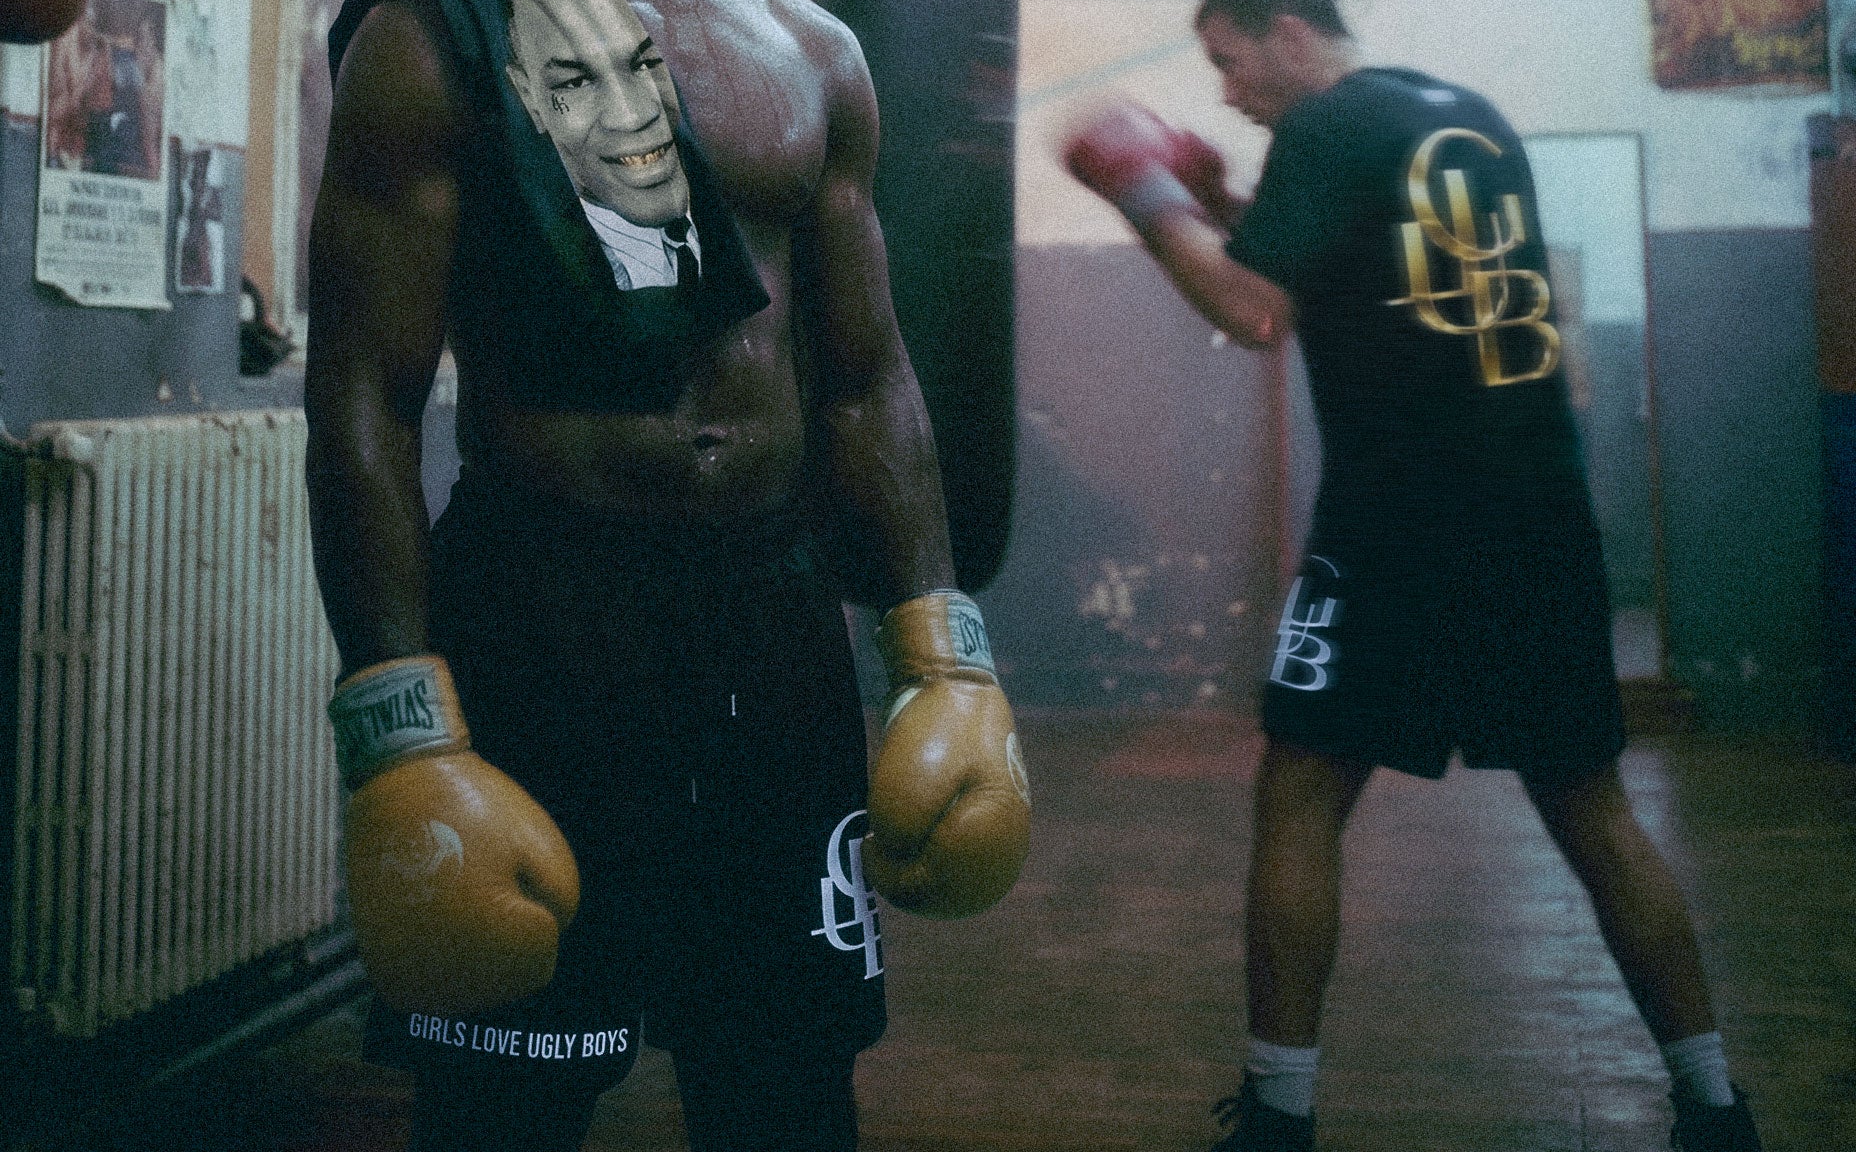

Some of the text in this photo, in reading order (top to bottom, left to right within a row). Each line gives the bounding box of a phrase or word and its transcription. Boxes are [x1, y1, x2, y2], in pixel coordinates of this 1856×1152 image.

[409, 1013, 629, 1059] GIRLS LOVE UGLY BOYS
